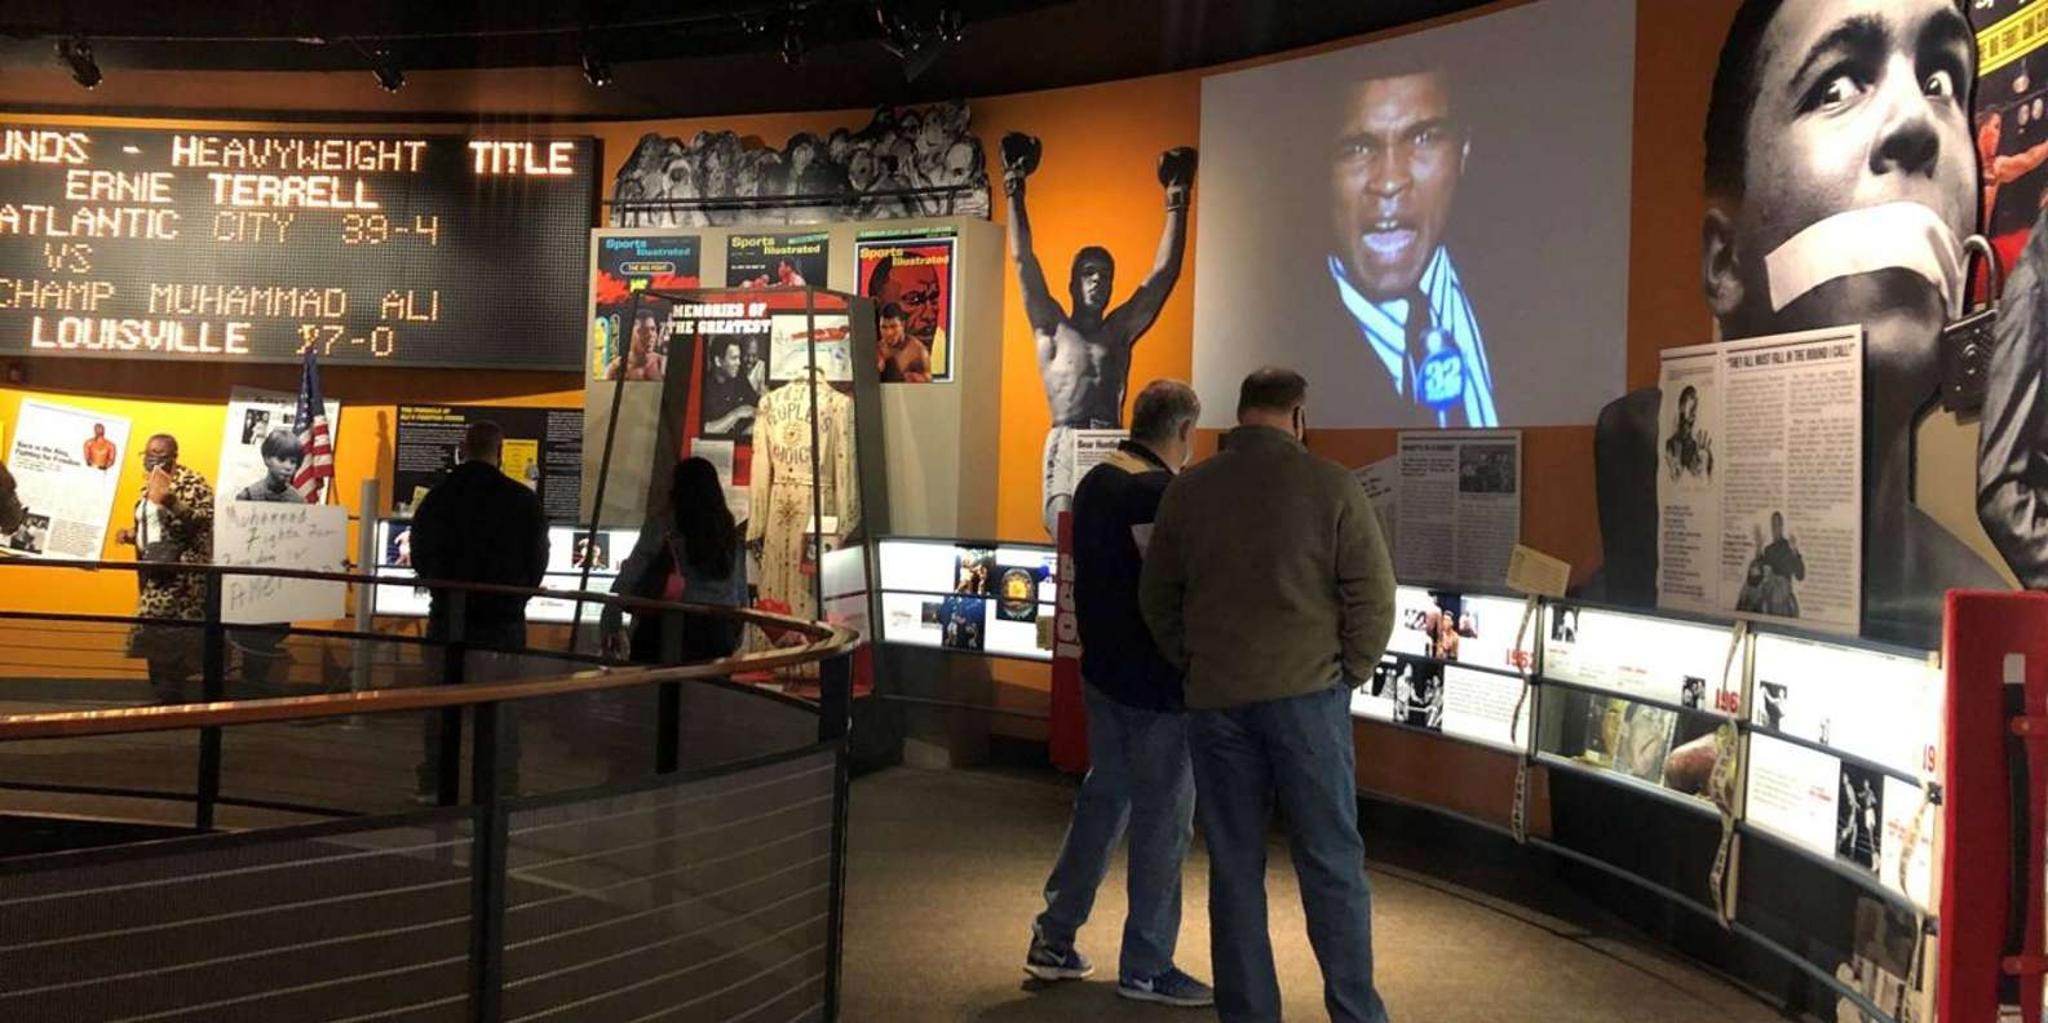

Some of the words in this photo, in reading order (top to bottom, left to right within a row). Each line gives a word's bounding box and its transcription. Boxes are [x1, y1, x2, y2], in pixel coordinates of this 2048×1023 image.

[172, 135, 427, 172] HEAVYWEIGHT
[468, 141, 574, 175] TITLE
[65, 170, 174, 203] ERNIE
[208, 172, 379, 209] TERRELL
[0, 203, 181, 240] ATLANTIC
[214, 211, 294, 244] CITY
[605, 238, 647, 251] Sports
[731, 236, 775, 249] Sports
[764, 244, 820, 255] Illustrated
[44, 242, 93, 273] VS
[637, 247, 691, 256] Illustrated
[860, 247, 904, 260] Sports
[892, 255, 949, 267] Illustrated
[0, 278, 115, 311] CHAMP
[149, 282, 347, 318] MUHAMMAD
[381, 290, 439, 321] ALI
[672, 303, 744, 318] MEMORIES
[748, 302, 767, 318] OF
[668, 320, 694, 334] THE
[698, 319, 771, 334] GREATEST
[31, 316, 251, 355] LOUISVILLE
